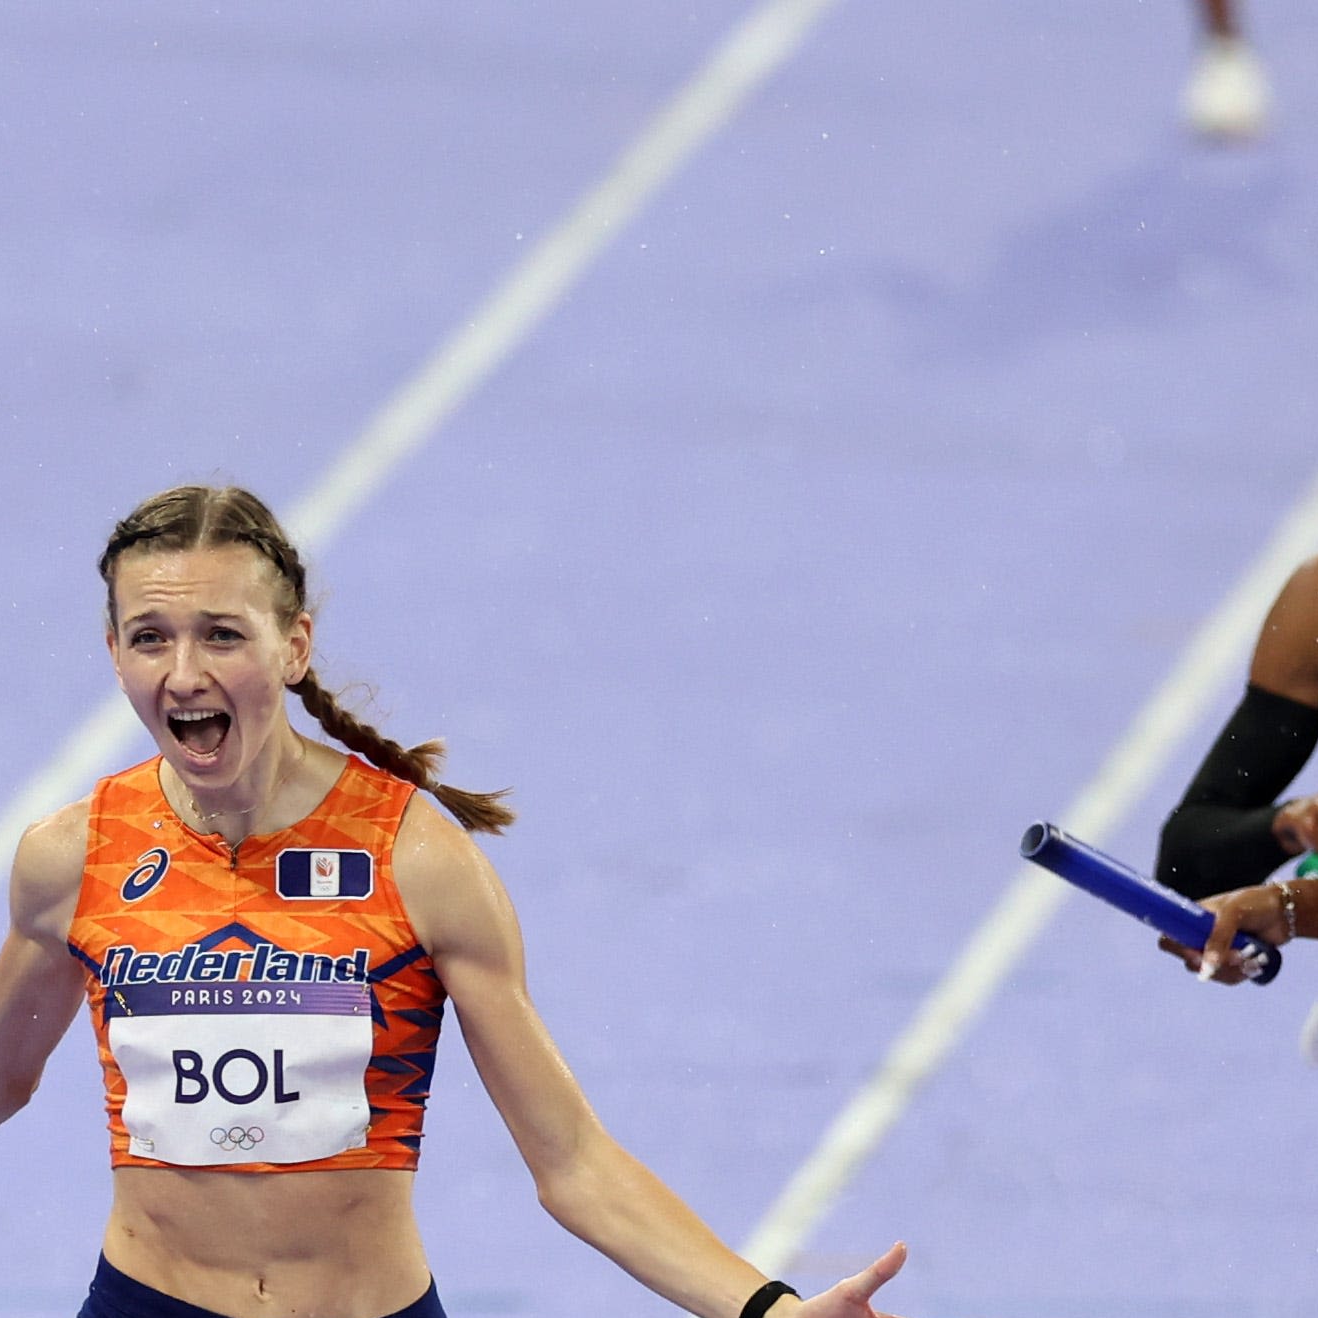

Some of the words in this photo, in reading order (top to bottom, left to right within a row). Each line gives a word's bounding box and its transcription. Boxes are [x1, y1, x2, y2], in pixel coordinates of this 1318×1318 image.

[100, 943, 371, 988] Nederland
[171, 989, 233, 1006] PARIS
[242, 989, 302, 1006] 2024
[172, 1048, 301, 1105] BOL
